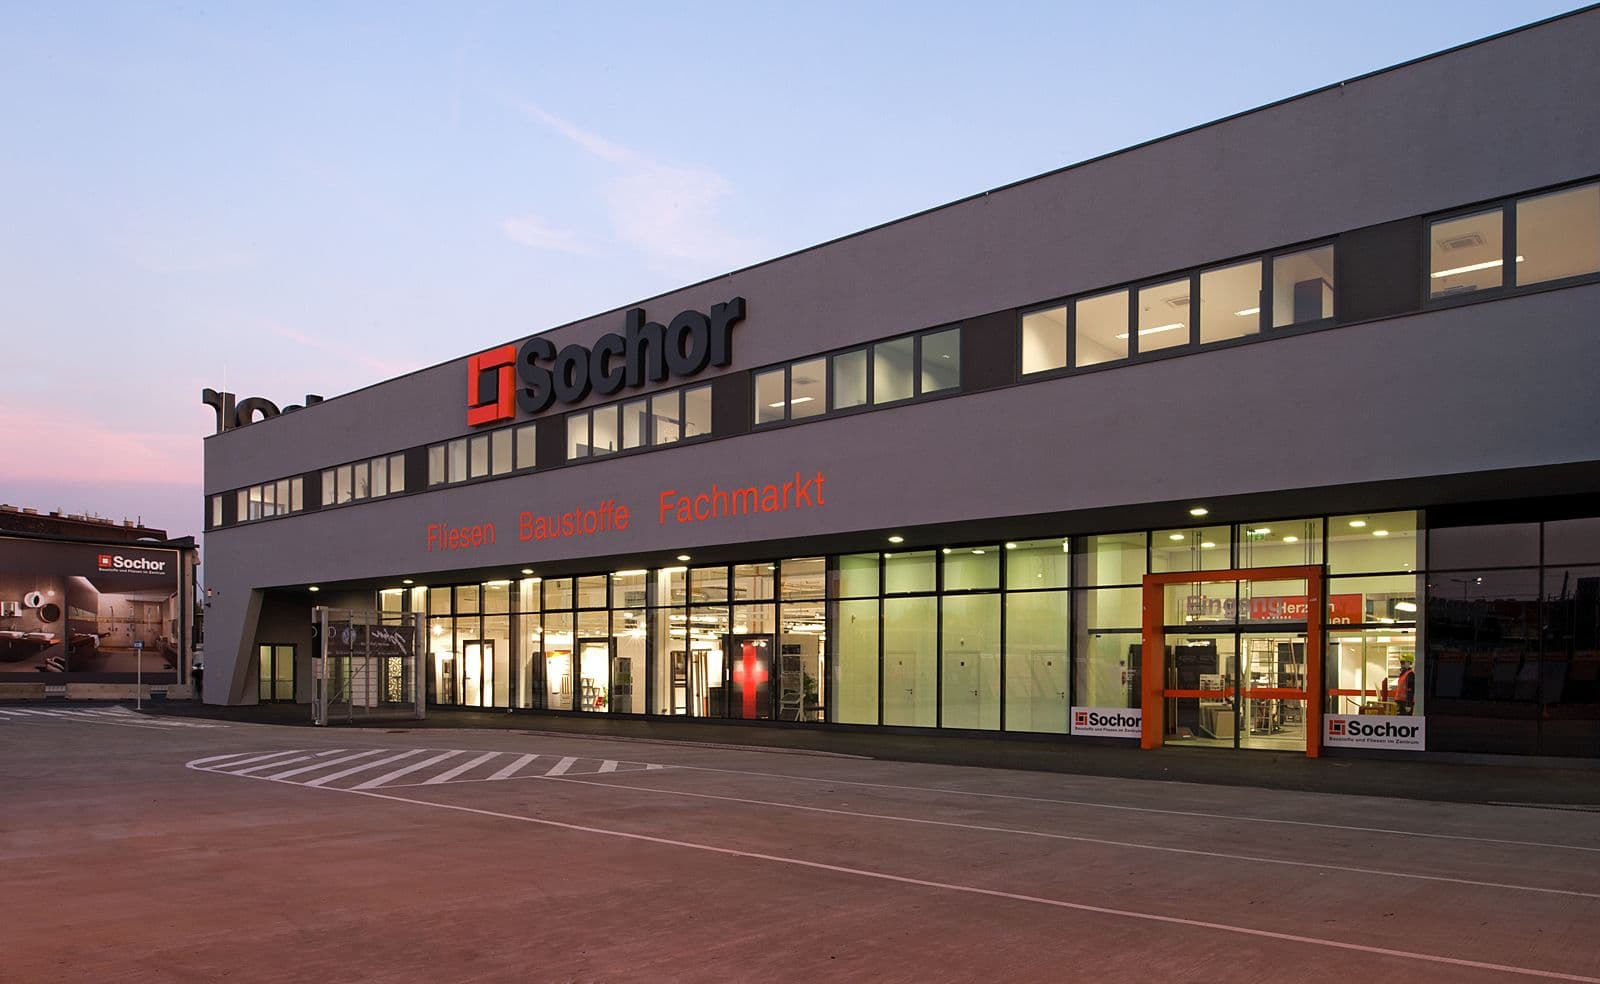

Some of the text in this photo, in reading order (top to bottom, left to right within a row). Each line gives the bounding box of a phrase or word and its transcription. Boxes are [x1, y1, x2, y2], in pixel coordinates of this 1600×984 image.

[516, 296, 746, 415] Sochor
[427, 471, 825, 552] Fliesen Baustoffe Fachmarkt
[113, 555, 166, 571] Sochor
[1089, 712, 1142, 728] Sochor
[1348, 720, 1419, 738] Sochor
